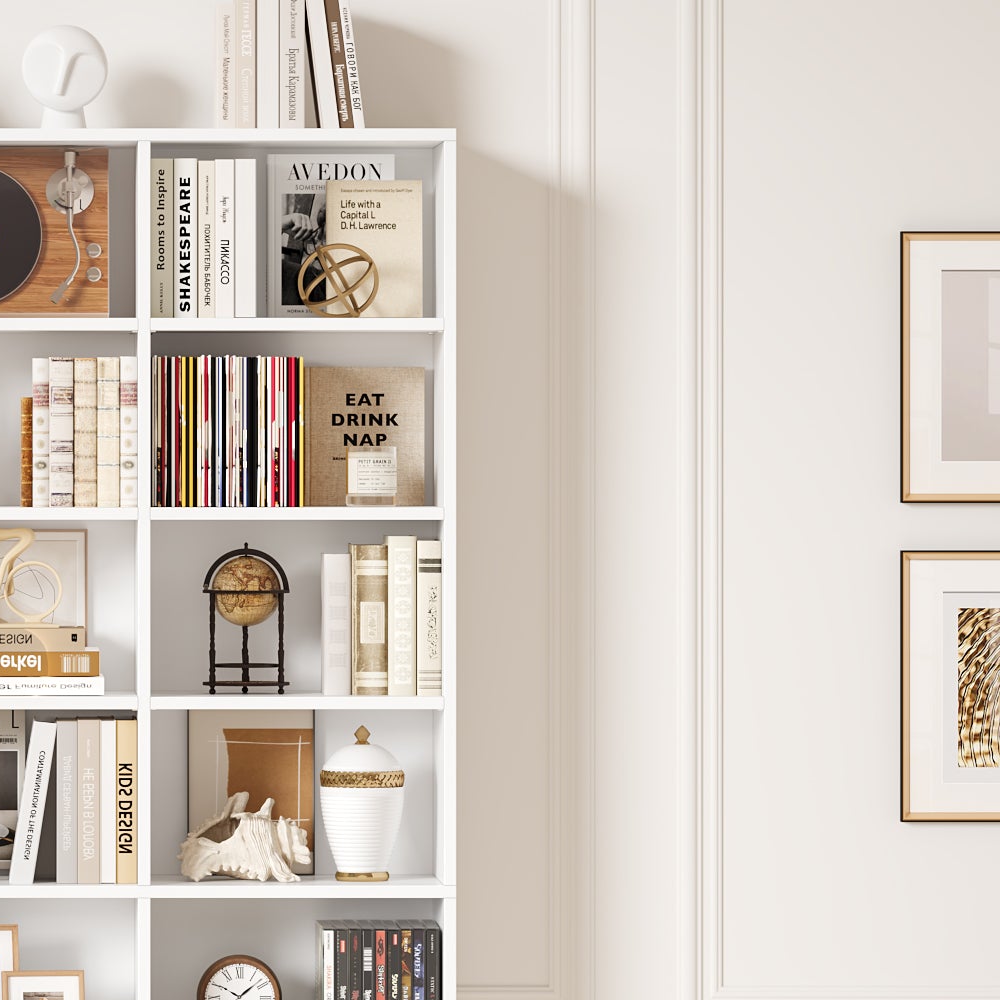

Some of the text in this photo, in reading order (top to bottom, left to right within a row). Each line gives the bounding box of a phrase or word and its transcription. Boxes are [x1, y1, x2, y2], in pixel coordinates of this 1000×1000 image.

[222, 57, 230, 90] Маленькие
[285, 48, 300, 121] Братья Карамазовы
[346, 42, 362, 111] ГОВОРИ КАК БОГ
[287, 163, 382, 181] AVEDON
[156, 169, 167, 270] Rooms to Inspire
[340, 200, 356, 209] Life
[357, 200, 375, 209] with
[340, 210, 375, 220] Capital L
[340, 222, 397, 230] D. H. Lawrence
[179, 177, 191, 313] SHAKESPEARE
[203, 223, 211, 272] ПОХИТИТЕЛЬ
[220, 239, 230, 285] ПИКАССО
[203, 273, 211, 307] БАБОЧЕК
[345, 393, 385, 406] EAT
[331, 413, 399, 426] DRINK
[343, 434, 387, 447] NAP
